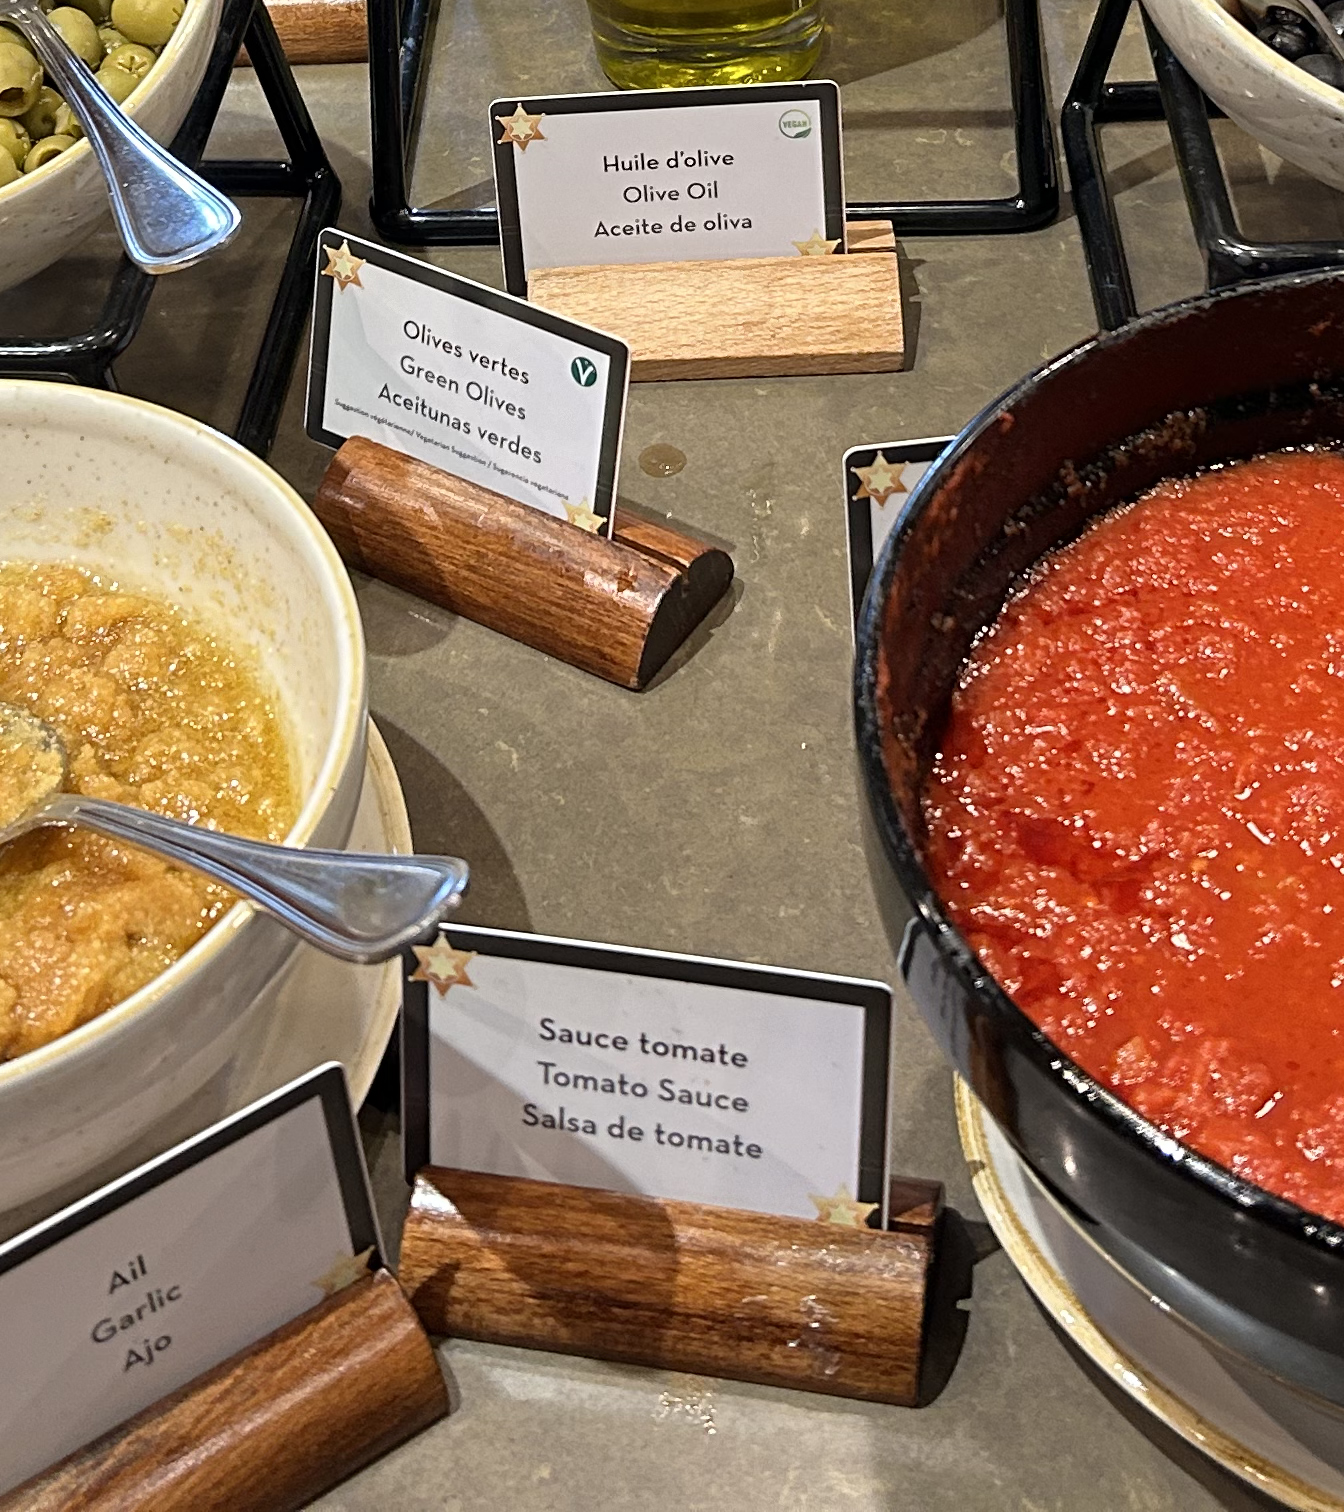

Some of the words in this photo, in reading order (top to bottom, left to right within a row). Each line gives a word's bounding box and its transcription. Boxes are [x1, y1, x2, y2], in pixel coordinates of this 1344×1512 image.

[782, 120, 807, 129] VEGAN
[603, 152, 659, 172] Huile
[666, 149, 735, 169] d'olive
[623, 183, 680, 203] Olive
[687, 181, 719, 200] Oil
[594, 218, 663, 238] Aceite
[669, 215, 696, 234] de
[703, 212, 753, 231] oliva
[403, 320, 463, 358] Olives
[469, 349, 530, 385] vertes
[400, 355, 459, 394] Green
[466, 381, 526, 420] Olives
[378, 383, 471, 434] Aceitunas
[478, 425, 542, 464] verdes
[538, 1017, 629, 1052] Sauce
[639, 1031, 749, 1069] tomate
[537, 1060, 649, 1098] Tomato
[659, 1077, 750, 1113] Sauce
[522, 1103, 597, 1137] Salsa
[607, 1115, 645, 1143] de
[655, 1123, 763, 1161] tomate
[107, 1254, 148, 1295] Ail
[91, 1284, 182, 1343] Garlic
[124, 1335, 172, 1372] Ajo
